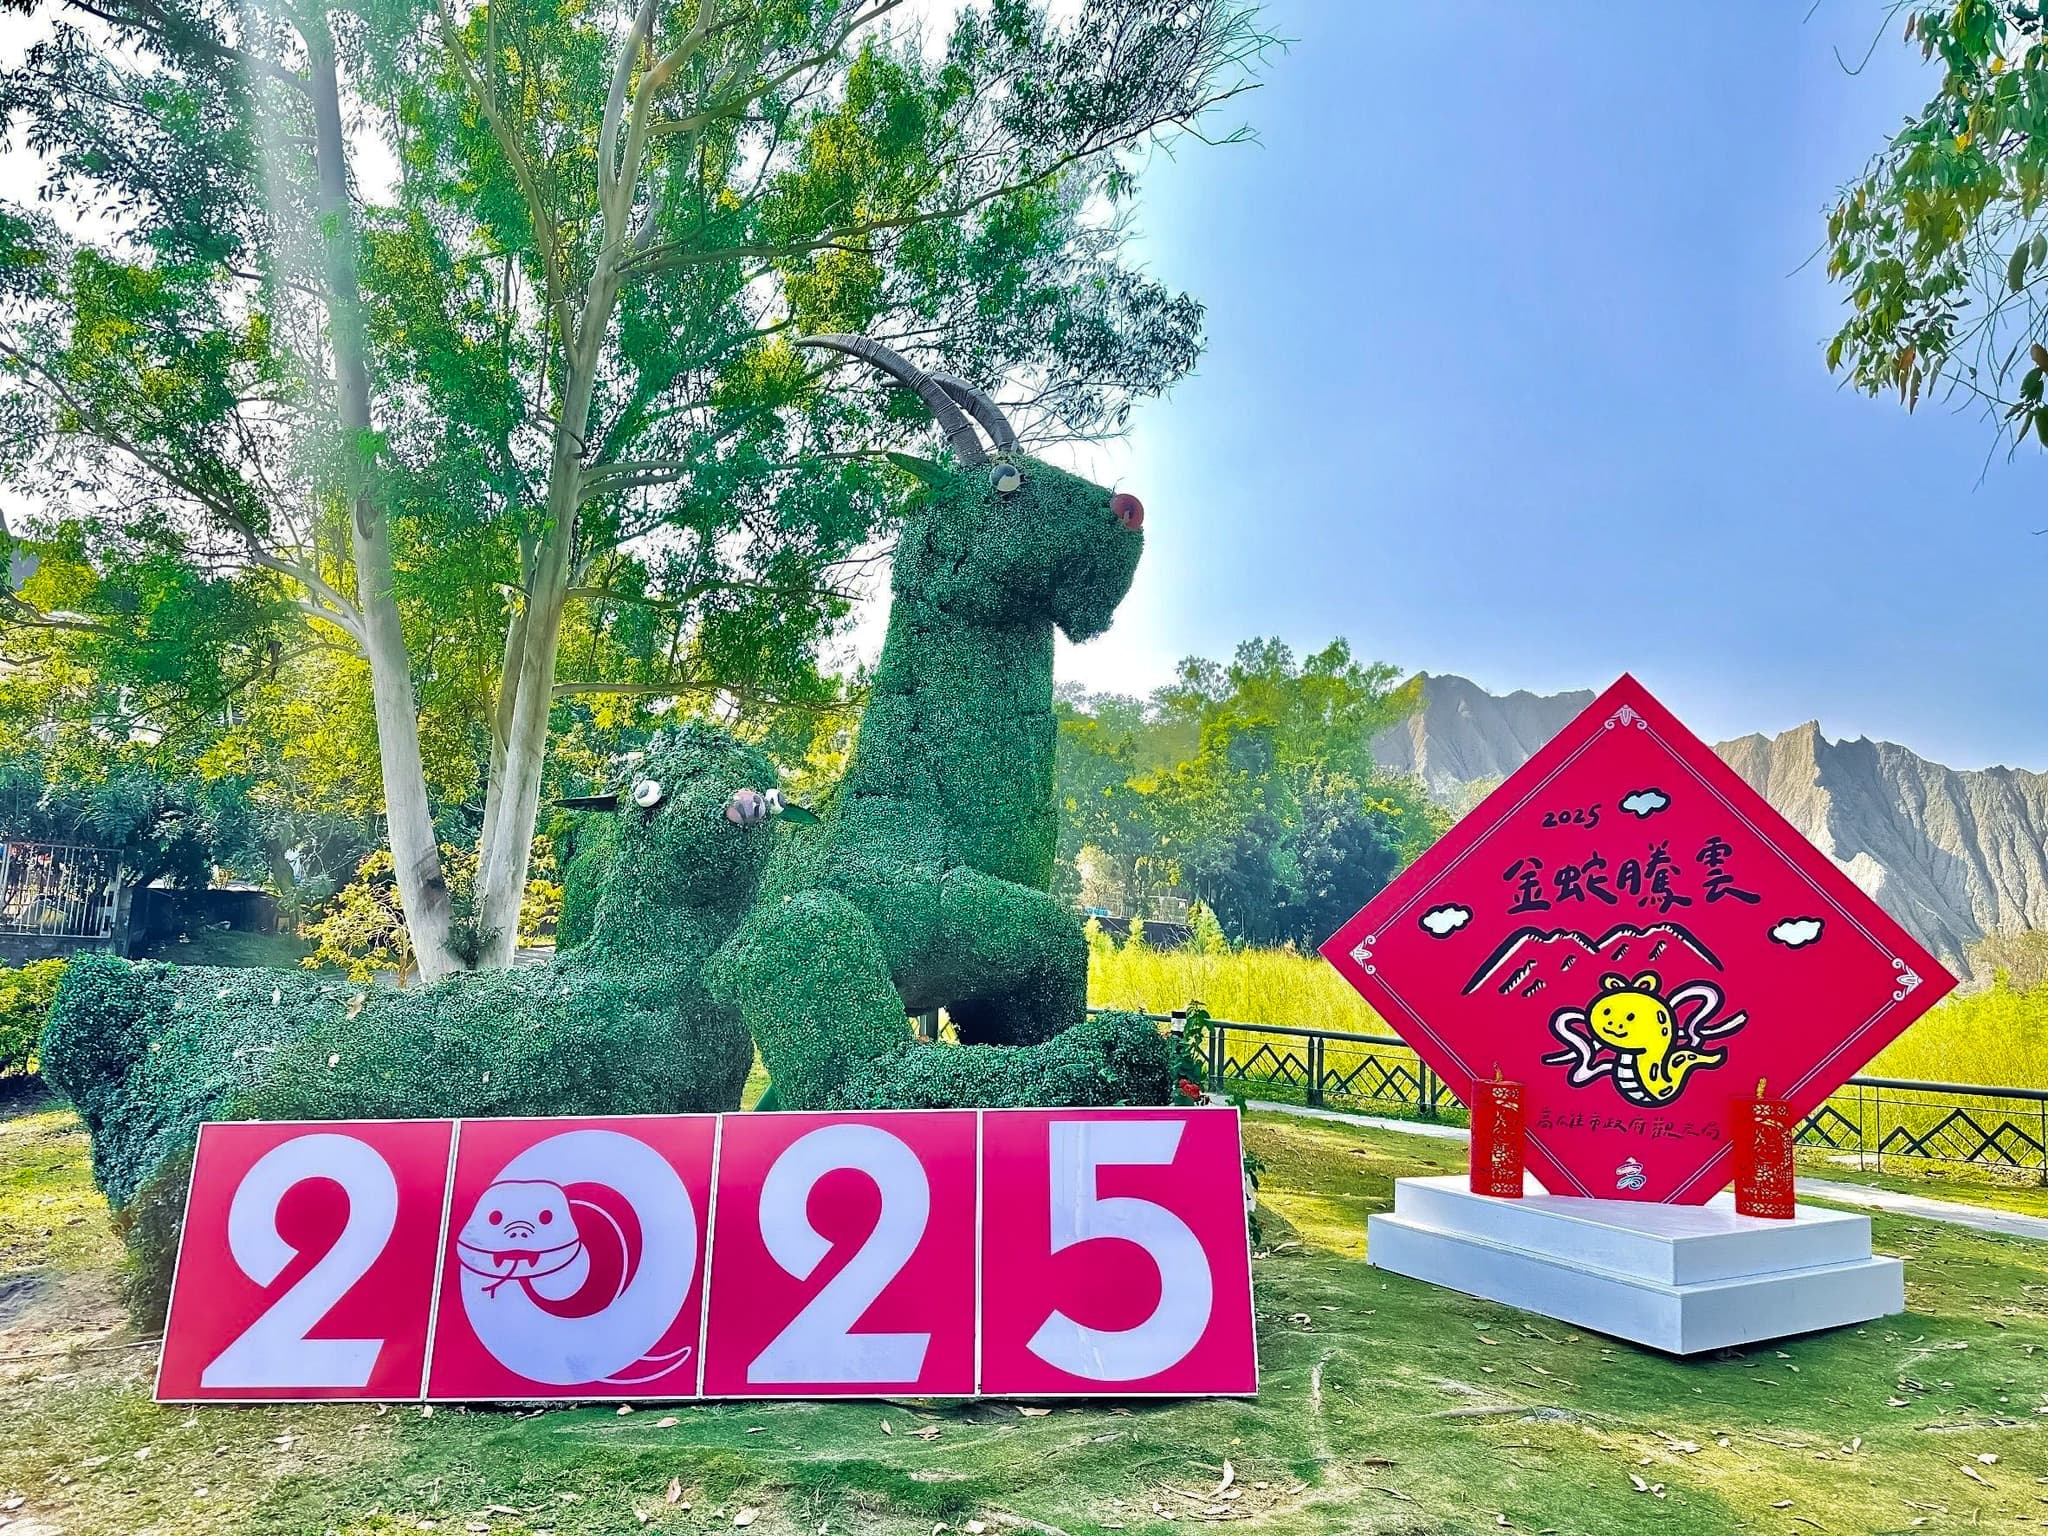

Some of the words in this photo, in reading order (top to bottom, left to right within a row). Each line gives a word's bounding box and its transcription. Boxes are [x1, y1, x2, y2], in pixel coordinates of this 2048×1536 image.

[1542, 803, 1602, 829] 2025
[1502, 836, 1762, 915] 金蛇騰雲
